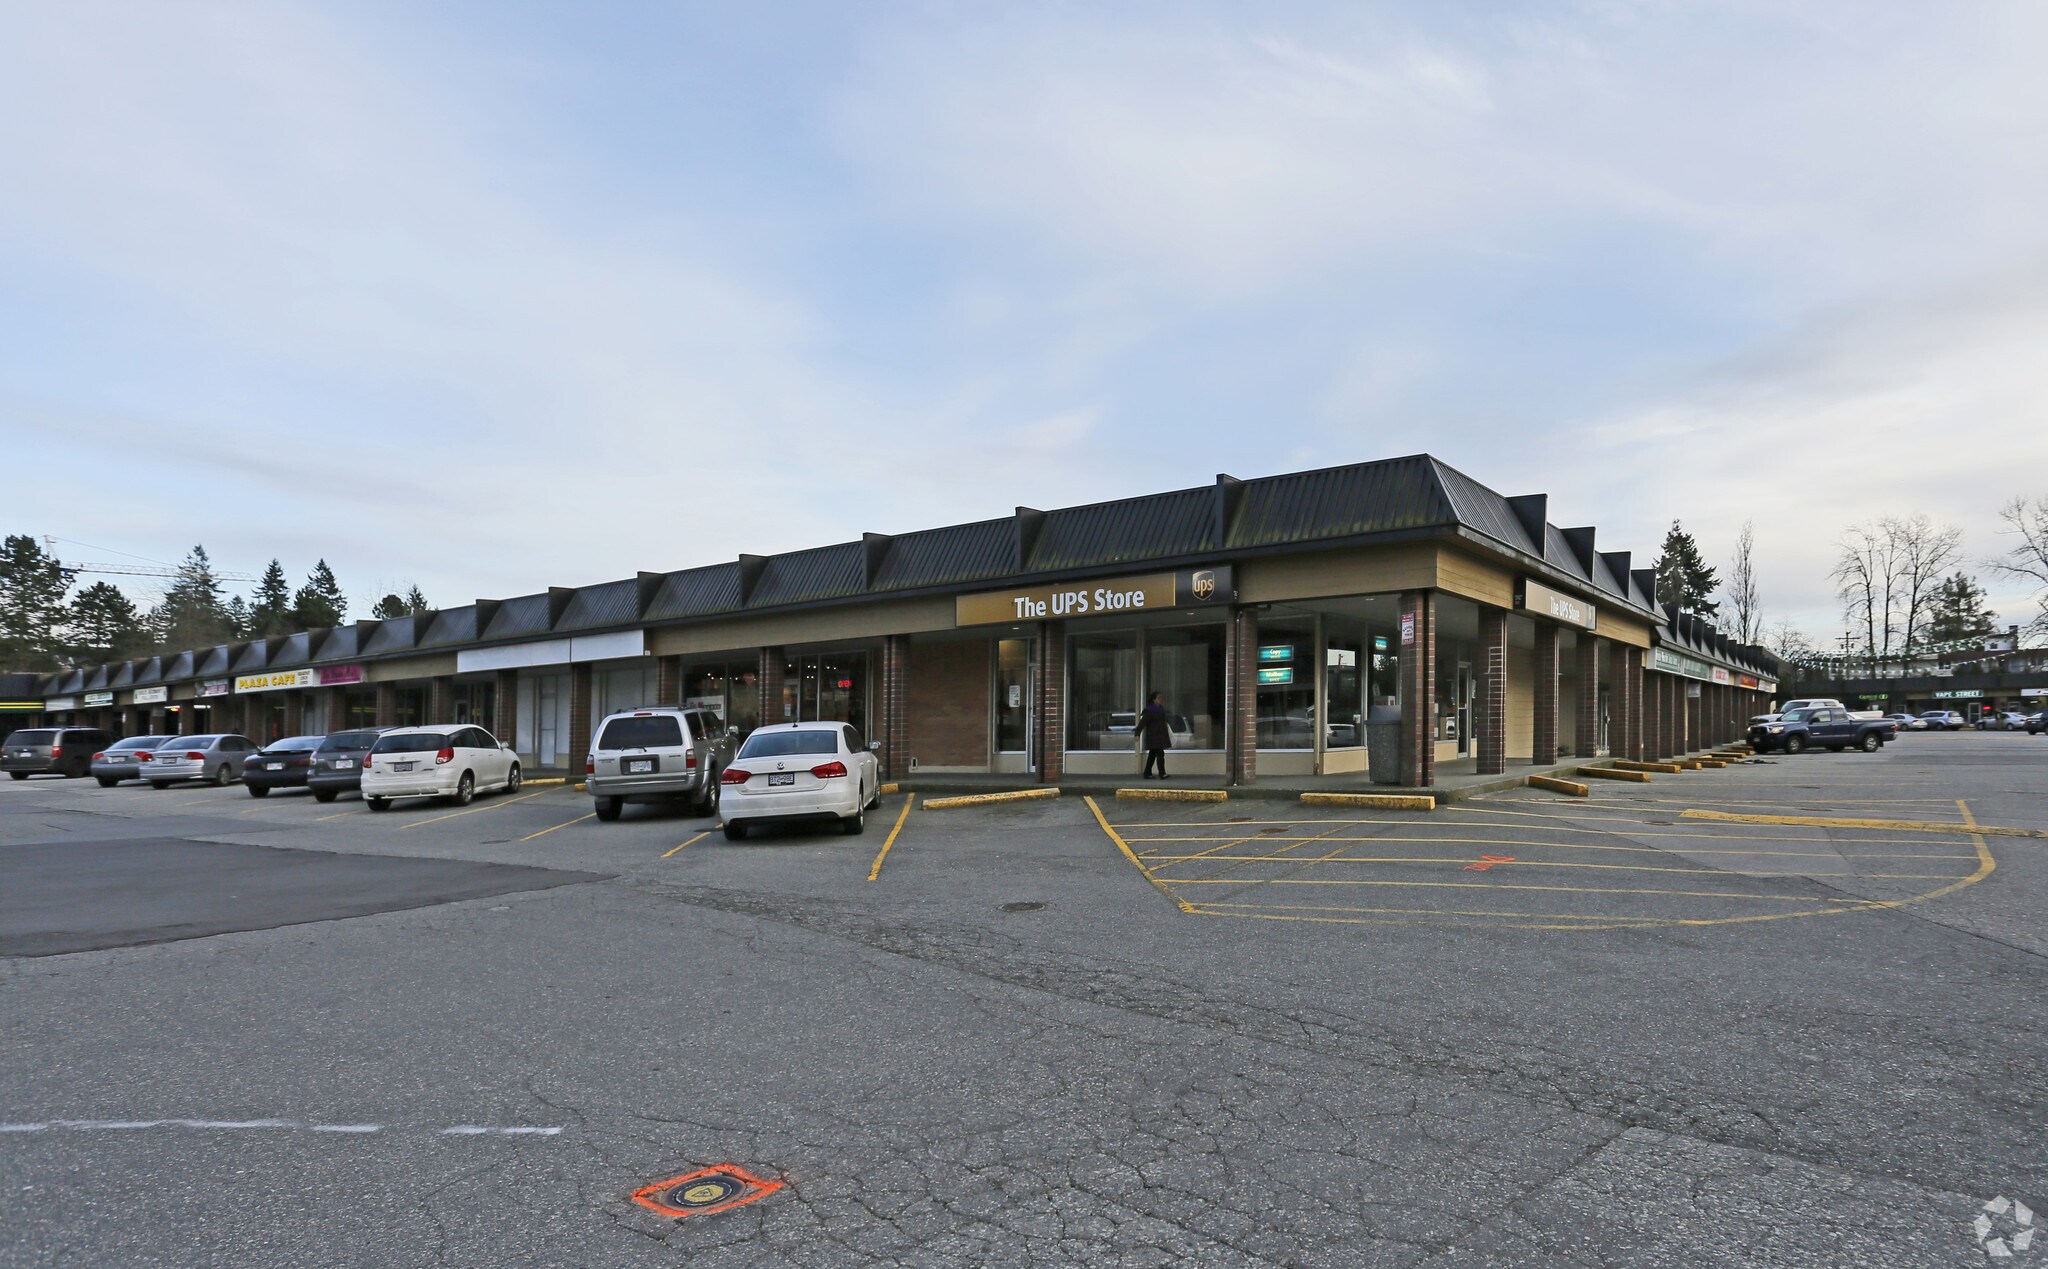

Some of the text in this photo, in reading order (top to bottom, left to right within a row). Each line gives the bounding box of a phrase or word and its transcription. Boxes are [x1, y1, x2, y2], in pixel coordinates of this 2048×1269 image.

[1194, 578, 1214, 596] ups
[1014, 588, 1145, 618] The UPS Store
[1550, 596, 1580, 622] The UPS Store
[239, 678, 268, 690] PLAZA
[271, 673, 296, 686] CAFE
[837, 679, 852, 688] OPEN
[1955, 690, 1980, 698] STREET
